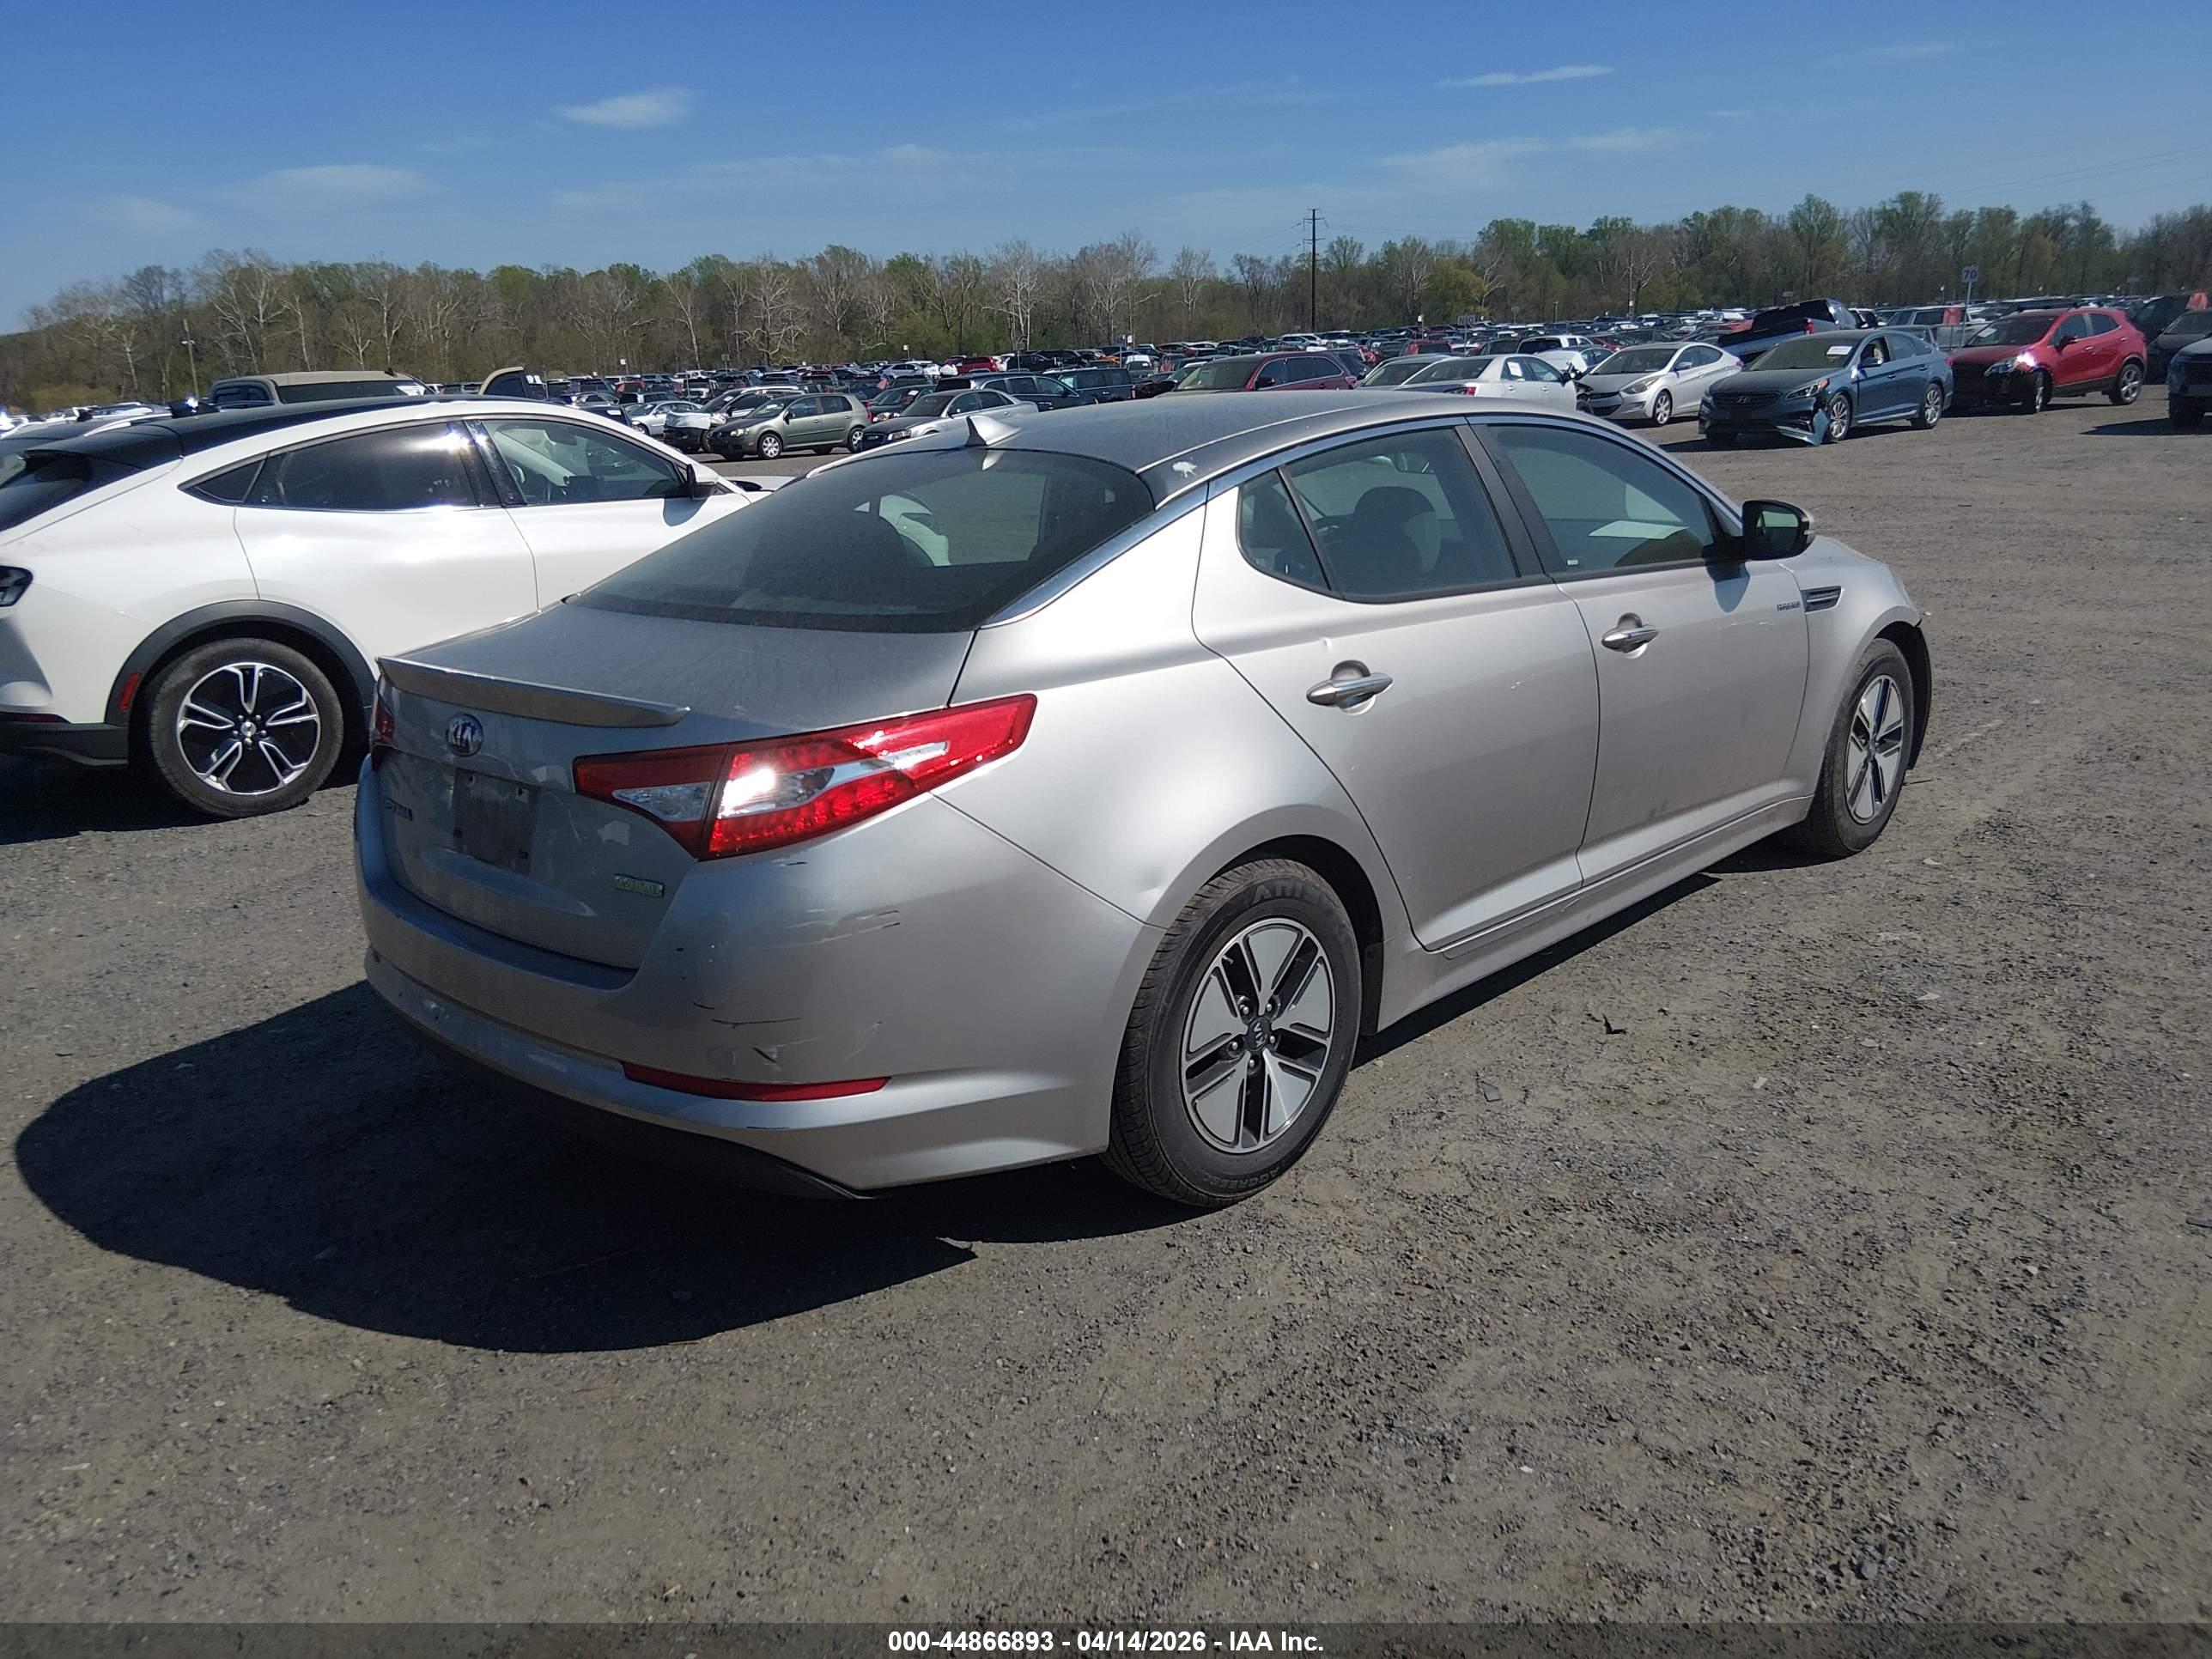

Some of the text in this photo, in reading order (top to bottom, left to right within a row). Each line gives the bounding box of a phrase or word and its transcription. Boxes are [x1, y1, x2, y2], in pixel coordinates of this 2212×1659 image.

[1964, 269, 1978, 280] 70
[447, 720, 477, 752] KIA
[1253, 1021, 1266, 1048] KIA
